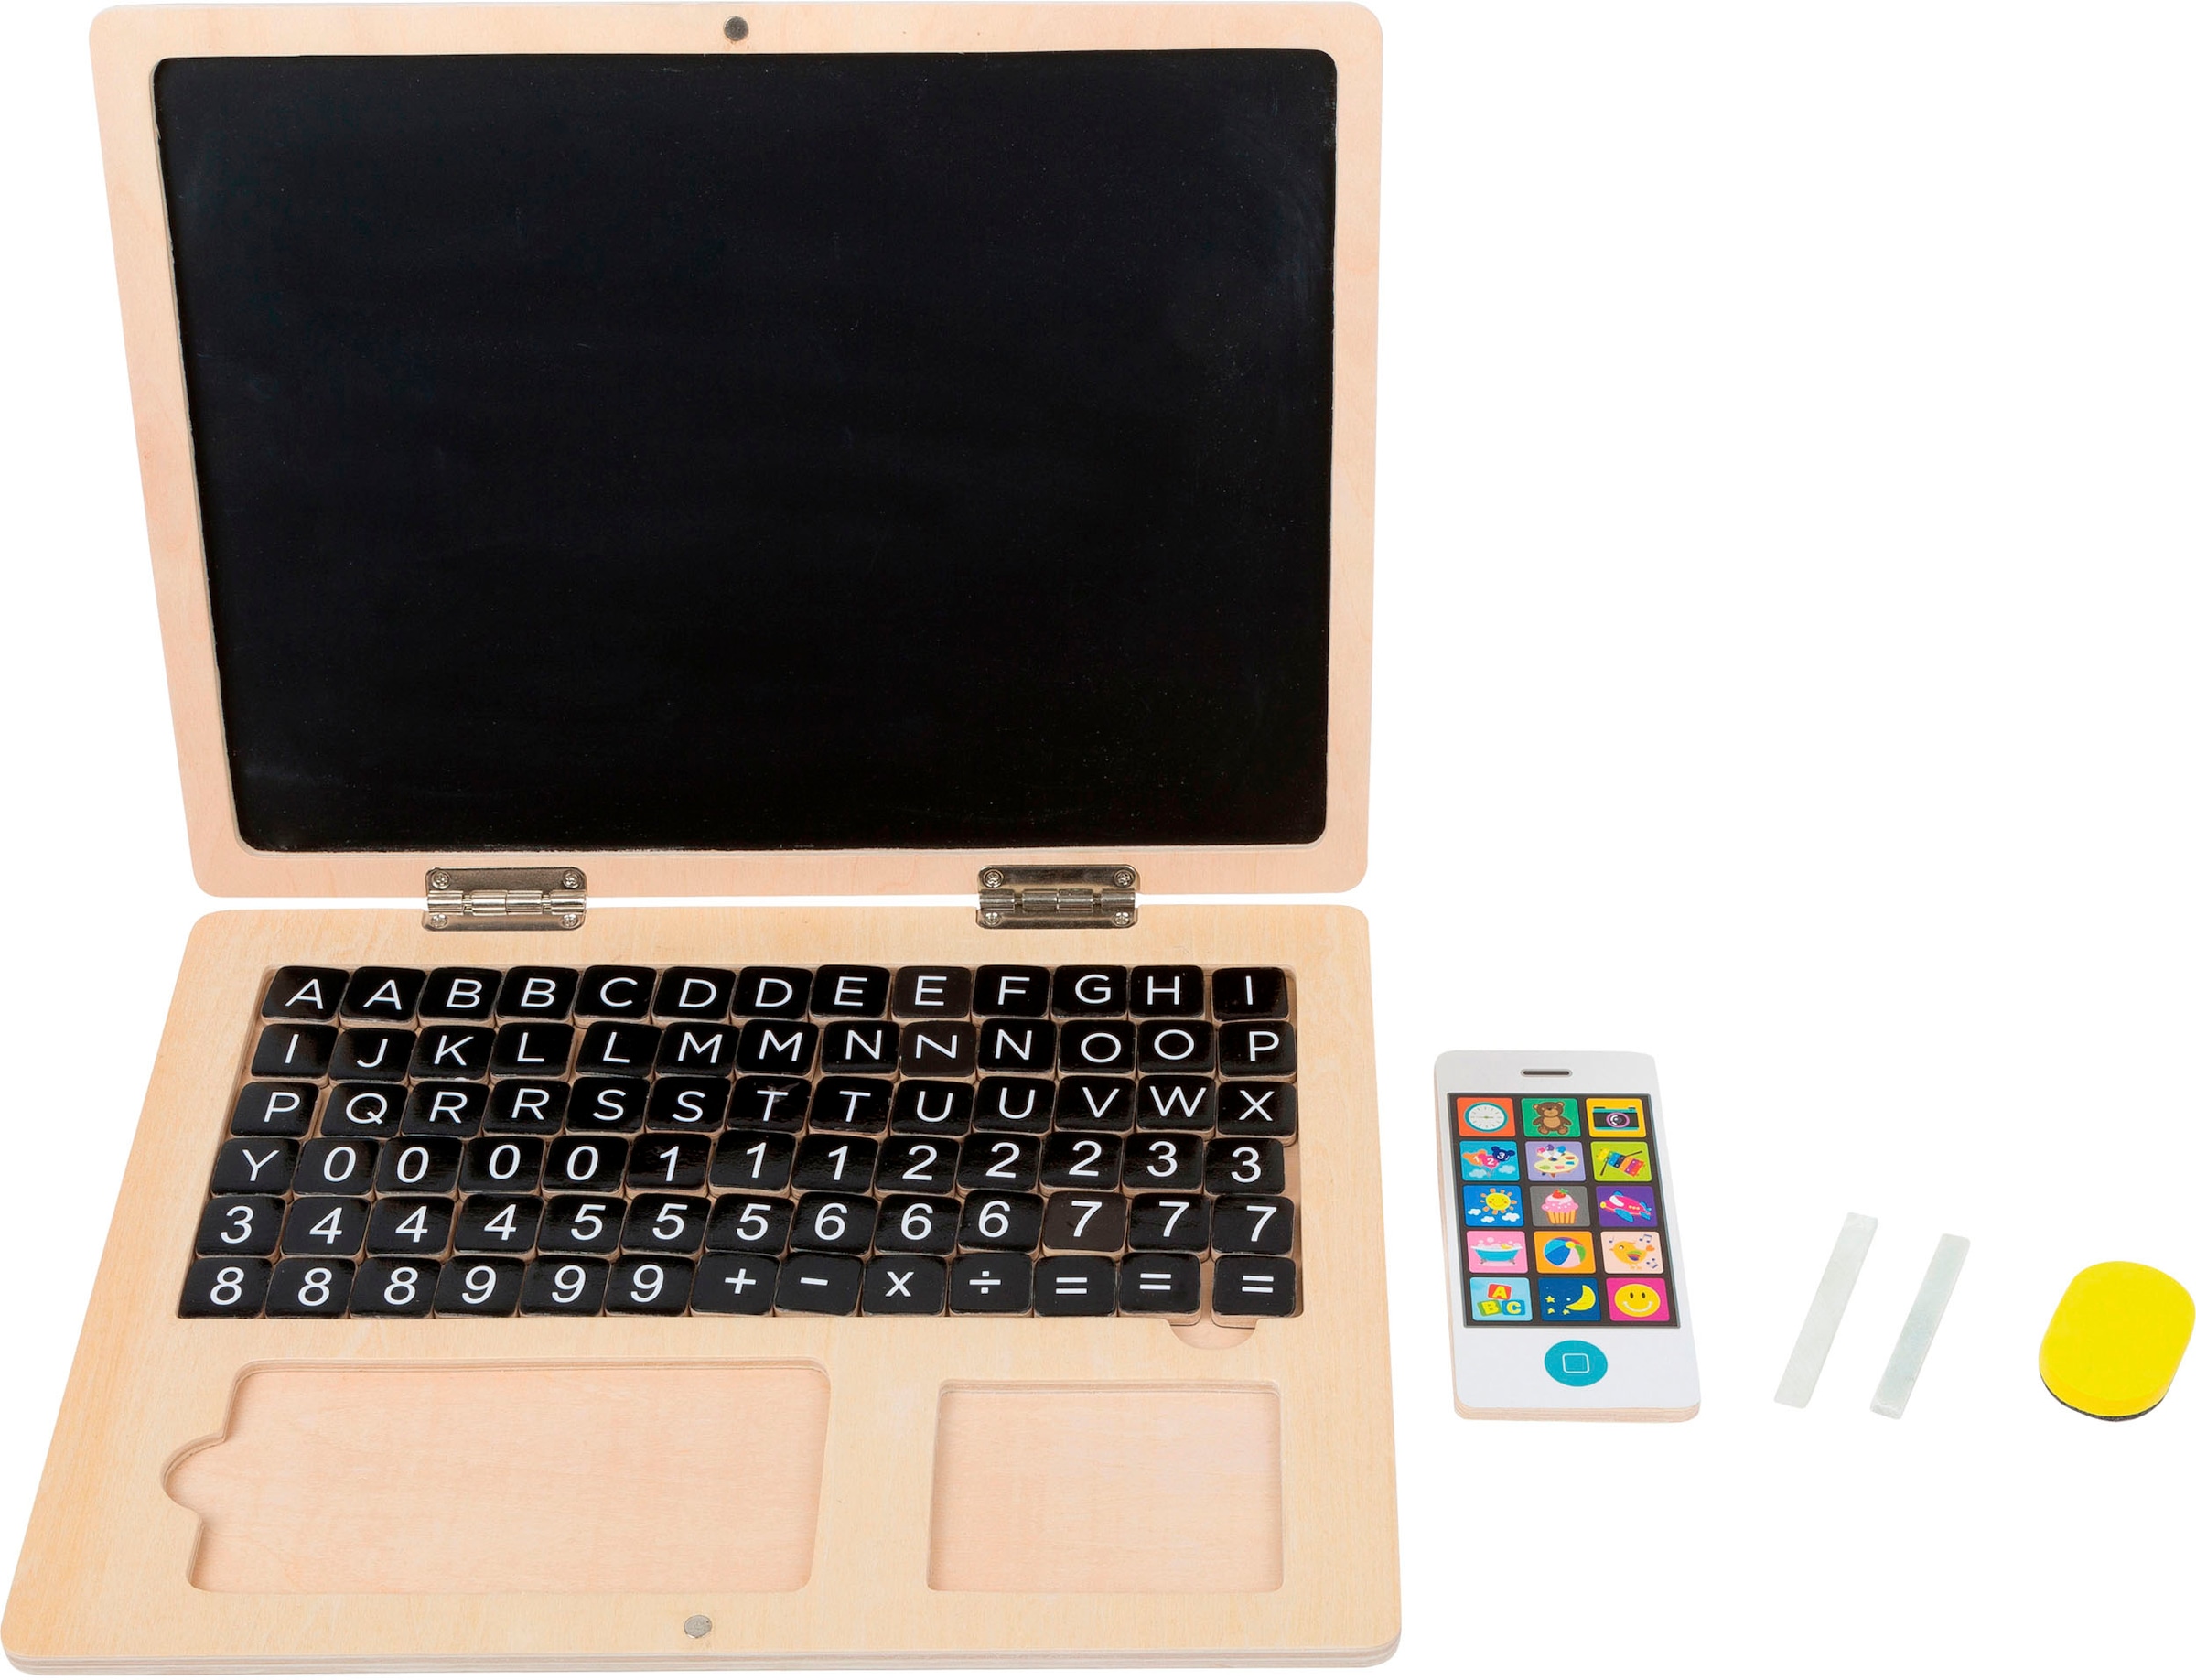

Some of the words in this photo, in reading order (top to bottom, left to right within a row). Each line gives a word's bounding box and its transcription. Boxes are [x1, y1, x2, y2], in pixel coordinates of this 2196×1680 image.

[285, 978, 324, 1009] A
[363, 979, 402, 1010] A
[446, 978, 483, 1007] B
[521, 977, 556, 1007] B
[600, 977, 638, 1007] C
[678, 978, 717, 1008] D
[755, 977, 793, 1007] D
[834, 976, 868, 1007] E
[914, 975, 947, 1007] E
[997, 975, 1030, 1006] F
[1074, 974, 1111, 1004] G
[1147, 975, 1180, 1005] H
[1245, 975, 1254, 1006] I
[285, 1033, 299, 1064] I
[356, 1038, 389, 1067] J
[434, 1035, 474, 1066] K
[517, 1032, 544, 1062] L
[602, 1031, 630, 1062] L
[677, 1031, 723, 1063] M
[759, 1029, 803, 1061] M
[845, 1029, 882, 1060] N
[915, 1034, 958, 1059] N
[995, 1028, 1033, 1061] N
[1080, 1032, 1122, 1063] O
[1154, 1028, 1195, 1060] O
[1249, 1030, 1280, 1061] P
[264, 1091, 301, 1123] P
[345, 1093, 388, 1125] Q
[429, 1091, 468, 1124] R
[511, 1088, 550, 1120] R
[593, 1089, 627, 1120] S
[672, 1090, 705, 1122] S
[757, 1090, 789, 1122] T
[839, 1090, 871, 1123] T
[916, 1091, 953, 1123] U
[998, 1087, 1036, 1119] U
[1082, 1086, 1120, 1118] V
[1149, 1085, 1207, 1118] W
[1239, 1090, 1275, 1122] X
[242, 1149, 280, 1182] Y
[323, 1146, 357, 1182] 0
[396, 1147, 429, 1183] 0
[489, 1144, 521, 1179] 0
[566, 1145, 599, 1181] 0
[660, 1146, 679, 1182] 1
[746, 1142, 767, 1179] 1
[828, 1145, 848, 1181] 1
[902, 1145, 938, 1181] 2
[985, 1142, 1020, 1179] 2
[1068, 1140, 1102, 1177] 2
[1146, 1140, 1178, 1178] 3
[1231, 1147, 1262, 1183] 3
[221, 1205, 254, 1244] 3
[309, 1207, 343, 1244] 4
[395, 1205, 428, 1243] 4
[484, 1203, 517, 1241] 4
[570, 1203, 606, 1241] 5
[652, 1202, 688, 1240] 5
[736, 1203, 771, 1241] 5
[814, 1202, 848, 1241] 6
[900, 1202, 933, 1241] 6
[978, 1200, 1011, 1238] 6
[1071, 1200, 1103, 1238] 7
[1158, 1201, 1190, 1238] 7
[1246, 1205, 1277, 1242] 7
[210, 1266, 245, 1306] 8
[297, 1267, 333, 1307] 8
[383, 1266, 419, 1305] 8
[461, 1265, 497, 1304] 9
[551, 1265, 587, 1303] 9
[630, 1264, 664, 1303] 9
[724, 1268, 757, 1295] +
[969, 1270, 1002, 1294] ÷
[1055, 1276, 1088, 1295] =
[1139, 1273, 1172, 1290] =
[1241, 1275, 1275, 1293] =
[1491, 1285, 1508, 1299] A
[1481, 1300, 1499, 1315] B
[1506, 1301, 1521, 1314] C
